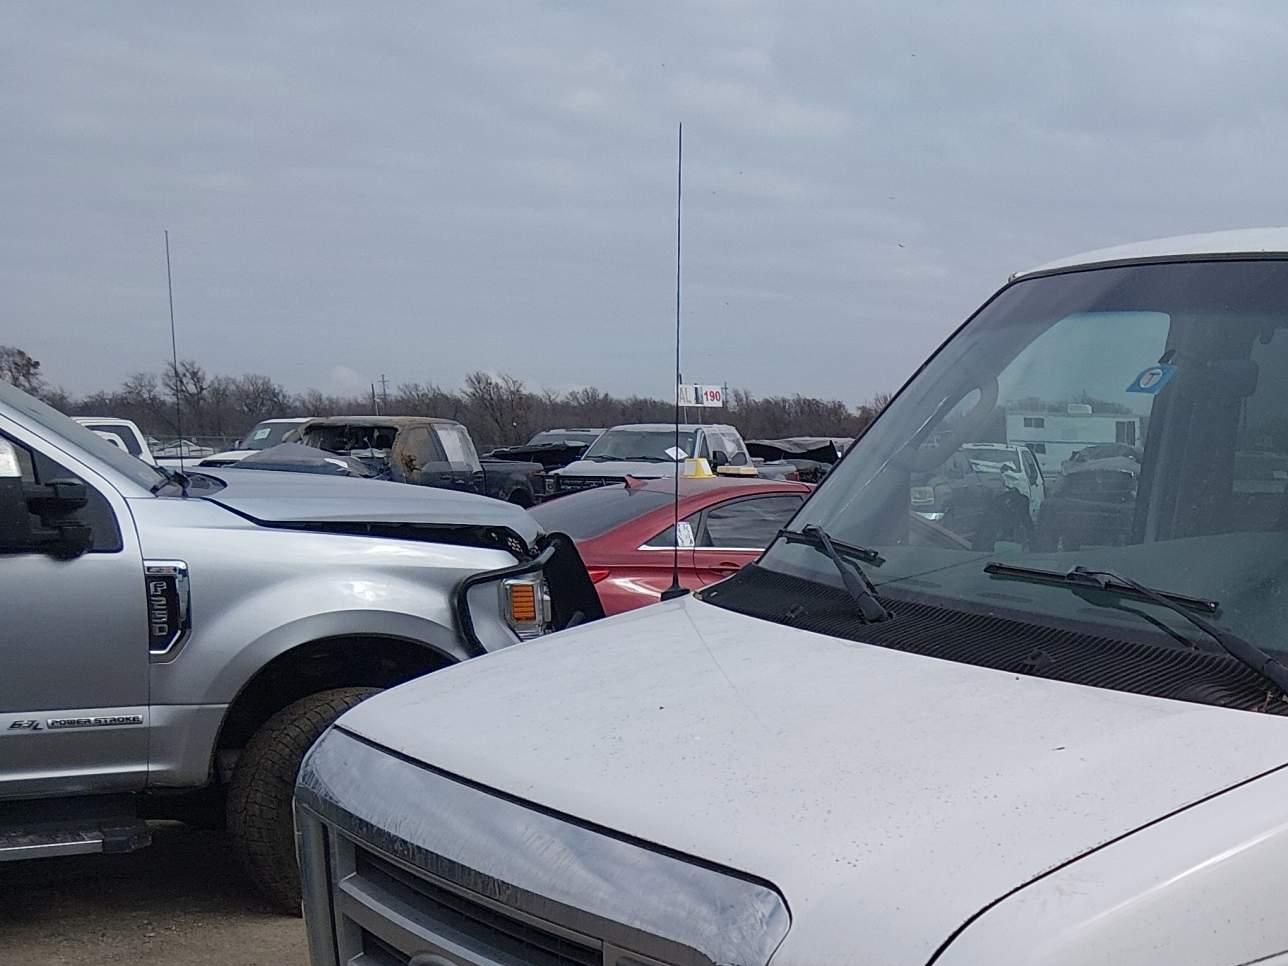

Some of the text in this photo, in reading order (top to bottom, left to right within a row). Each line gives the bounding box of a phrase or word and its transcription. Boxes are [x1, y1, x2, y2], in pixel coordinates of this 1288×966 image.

[704, 390, 721, 402] 190
[50, 717, 92, 727] POWER
[94, 715, 141, 724] STROKE
